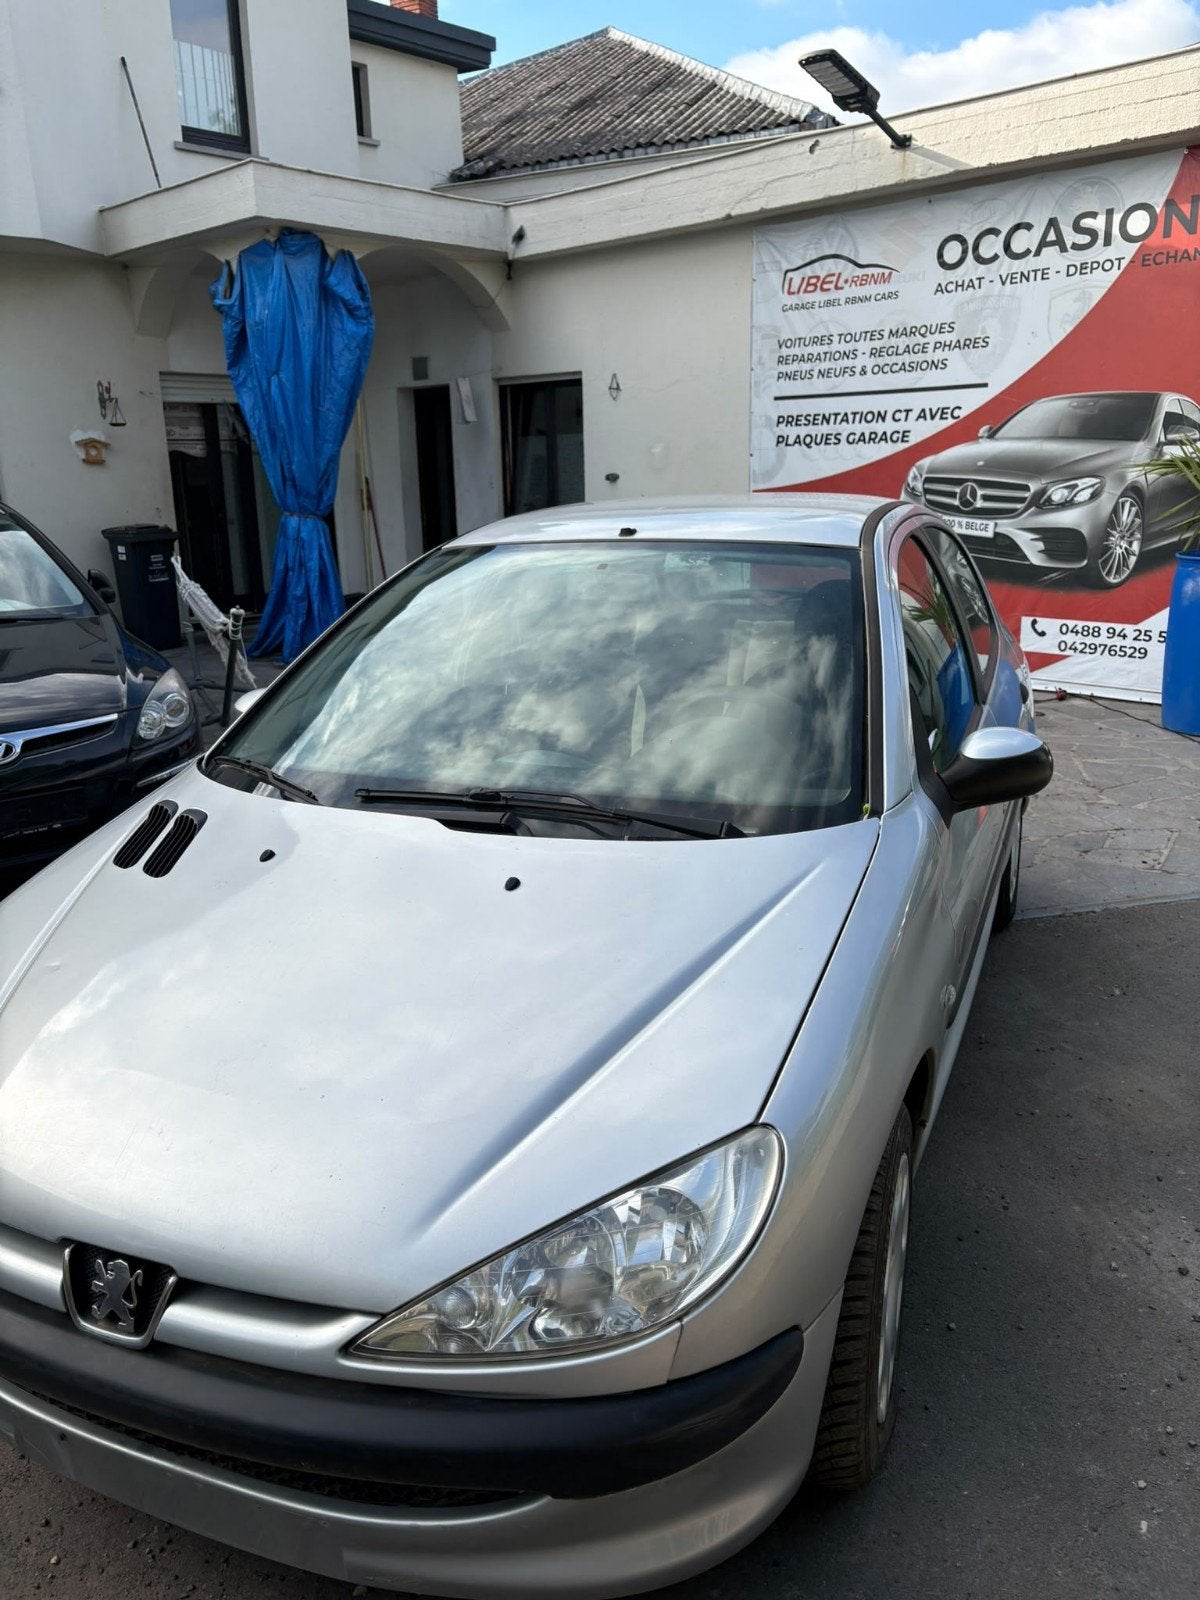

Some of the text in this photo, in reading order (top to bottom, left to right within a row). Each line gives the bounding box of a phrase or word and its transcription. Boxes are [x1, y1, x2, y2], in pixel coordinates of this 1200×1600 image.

[936, 194, 1200, 271] OCCASION
[933, 276, 985, 295] ACHAT
[998, 267, 1050, 286] VENTE
[1066, 256, 1125, 277] DEPOT
[781, 290, 900, 313] GARAGE LIBEL RBNM CARS
[777, 321, 956, 350] VOITURES TOUTES MARQUES
[777, 348, 858, 366] REPARATIONS
[869, 342, 930, 359] REGLAGE
[933, 336, 990, 352] PHARES
[776, 358, 948, 382] PNEUS NEUFS & OCCASIONS
[776, 405, 962, 428] PRESENTATION CT AVEC
[775, 430, 911, 449] PLAQUES GARAGE
[964, 521, 990, 533] BELGE
[1059, 623, 1101, 638] 0488
[1106, 626, 1128, 640] 94
[1132, 628, 1153, 643] 25
[1057, 640, 1148, 660] 042976529
